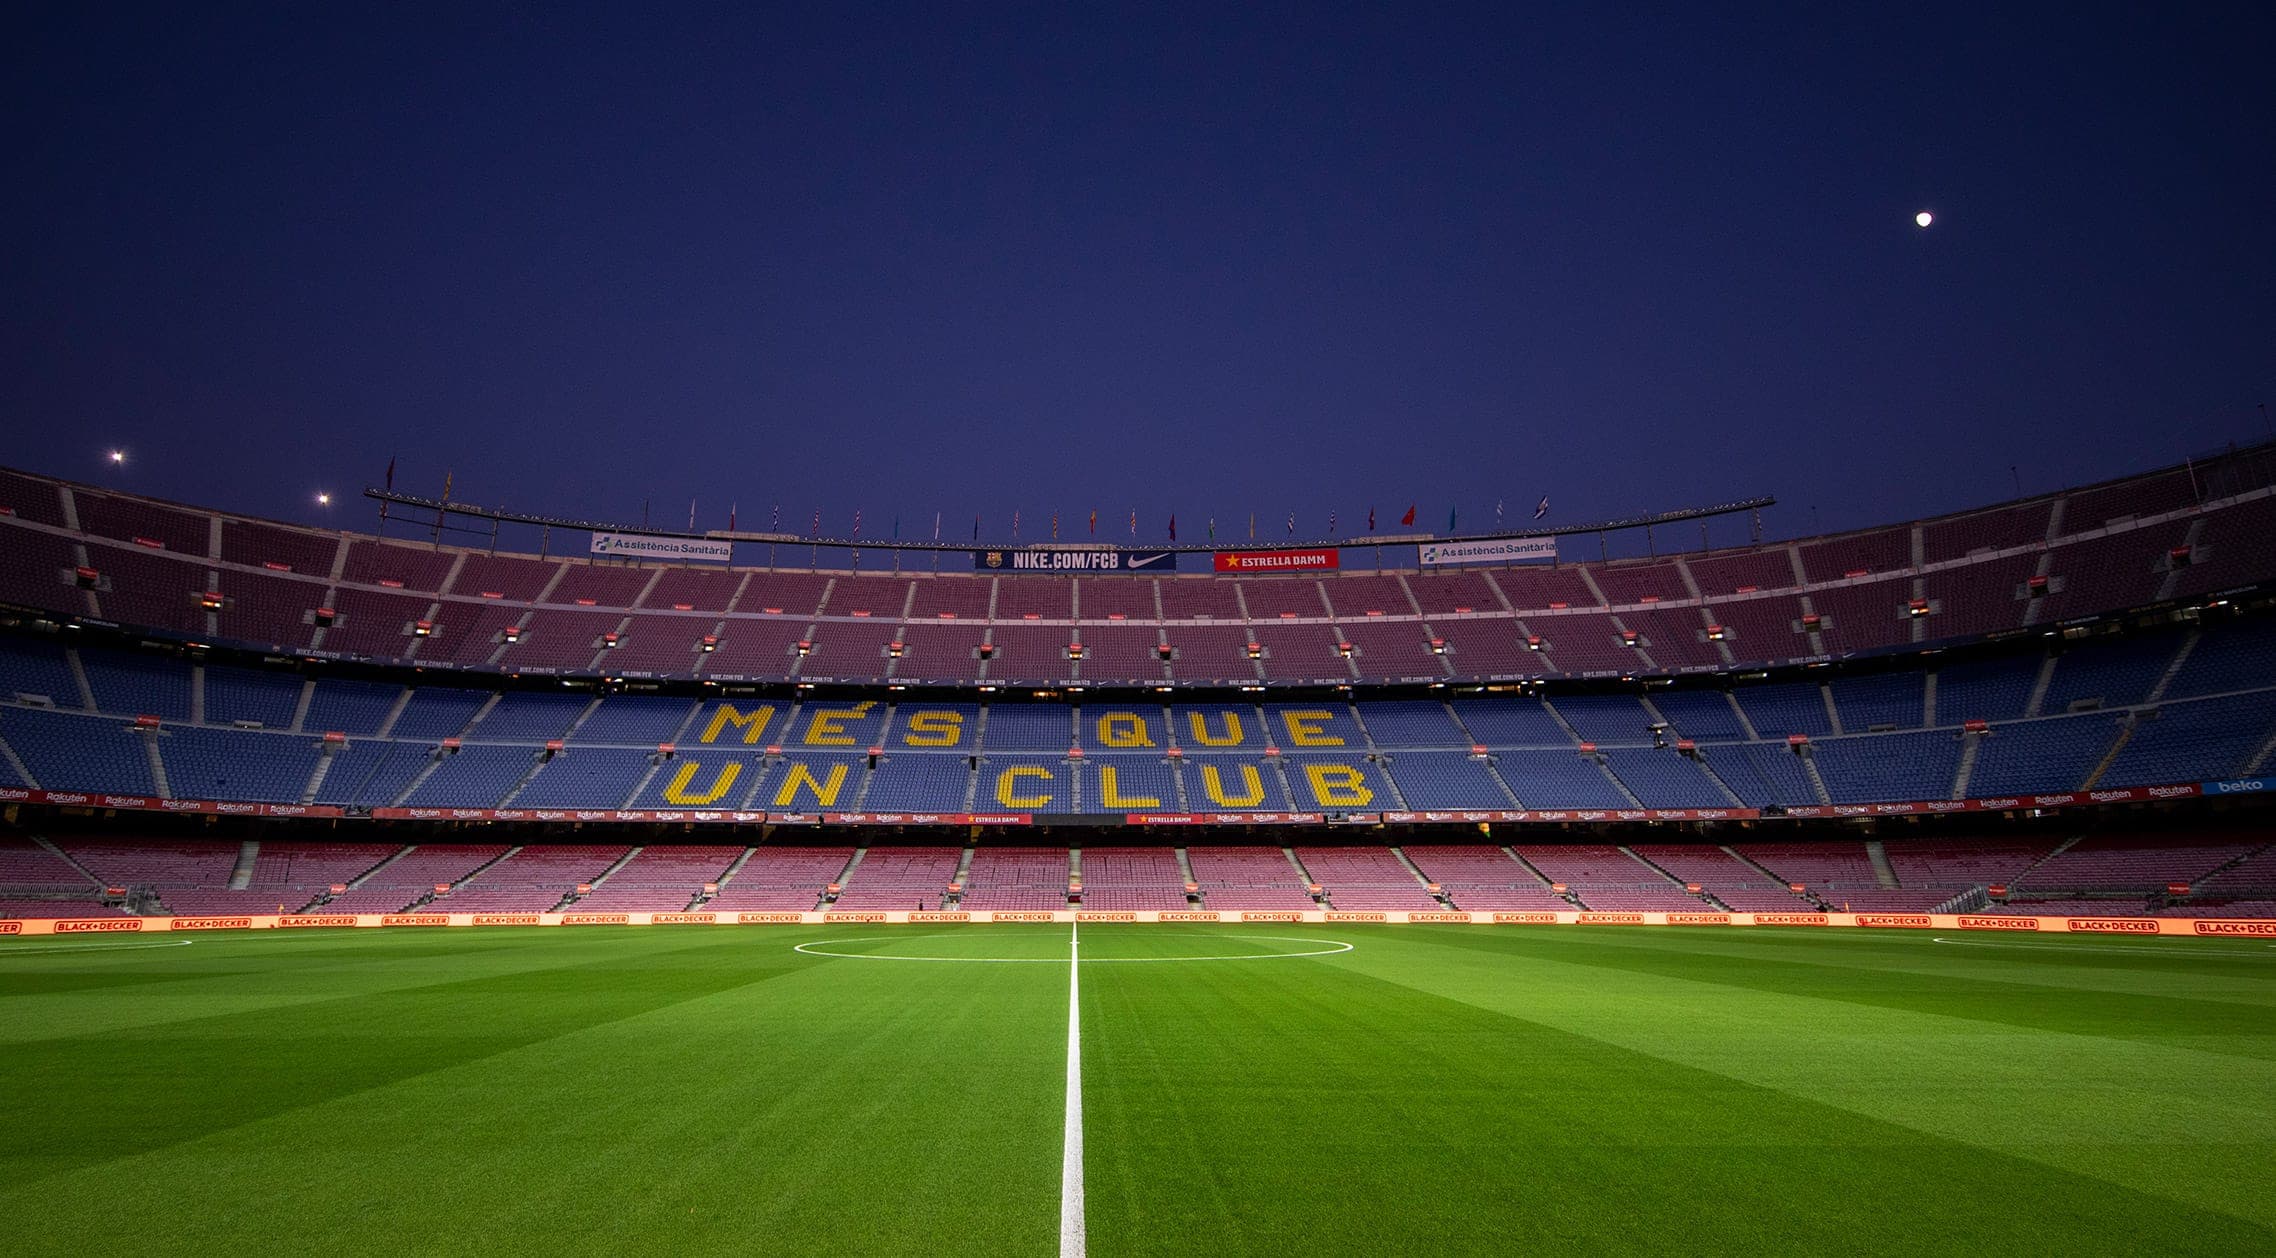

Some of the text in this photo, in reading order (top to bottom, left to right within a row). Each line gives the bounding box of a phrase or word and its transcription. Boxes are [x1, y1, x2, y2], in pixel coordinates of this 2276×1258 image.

[614, 539, 729, 556] Assistència Sanitària
[1441, 542, 1556, 557] Assistència Sanitària
[1013, 552, 1119, 569] NIKE.COM/FCB
[1242, 555, 1326, 567] ESTRELLA DAMM
[700, 701, 1345, 747] MÉS QUE
[662, 762, 1374, 808] UN CLUB
[2218, 781, 2263, 792] beko
[0, 789, 28, 799] kuten
[2090, 791, 2131, 801] Rakuten
[2149, 786, 2193, 797] Rakuten
[47, 793, 87, 804] Rakuten
[105, 796, 145, 807] Rakuten
[1980, 798, 2018, 808] Rakuten
[2035, 795, 2073, 805] Rakuten
[162, 799, 200, 810] Rakuten
[217, 803, 254, 812] Rakuten
[1878, 804, 1913, 813] Rakuten
[1928, 801, 1965, 812] Rakuten
[270, 805, 305, 815] Rakuten
[174, 919, 249, 928] BLACK+DECKER
[281, 918, 354, 926] BLACK+DECKER
[1669, 915, 1729, 923] BLACK+DECKER
[1858, 917, 1928, 925] BLACK+DECKER
[1961, 918, 2036, 927] BLACK+DECKER
[58, 921, 139, 931] BLACK+DECKER
[2071, 920, 2156, 931] BLACK+DECKER
[2199, 923, 2276, 933] BLACK+DEC
